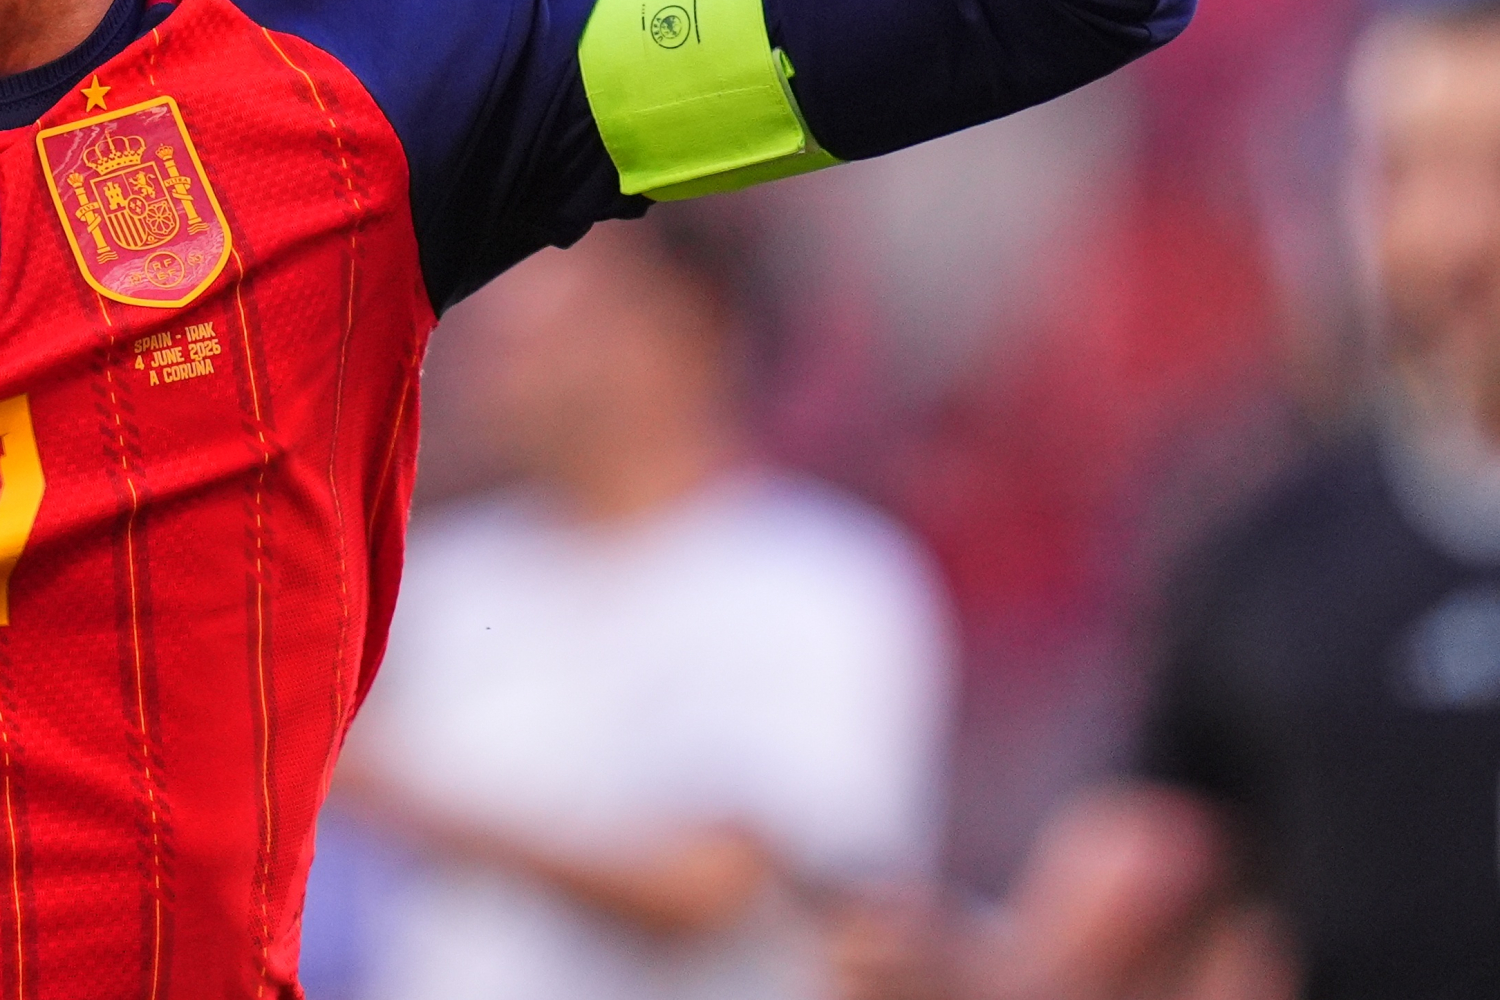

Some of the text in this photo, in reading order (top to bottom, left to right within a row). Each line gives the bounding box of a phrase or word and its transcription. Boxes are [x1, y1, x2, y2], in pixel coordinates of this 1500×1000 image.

[134, 331, 172, 353] SPAIN
[185, 321, 216, 342] IRAK
[134, 338, 221, 371] 4 JUNE 2026
[149, 355, 214, 386] A CORUÑA
